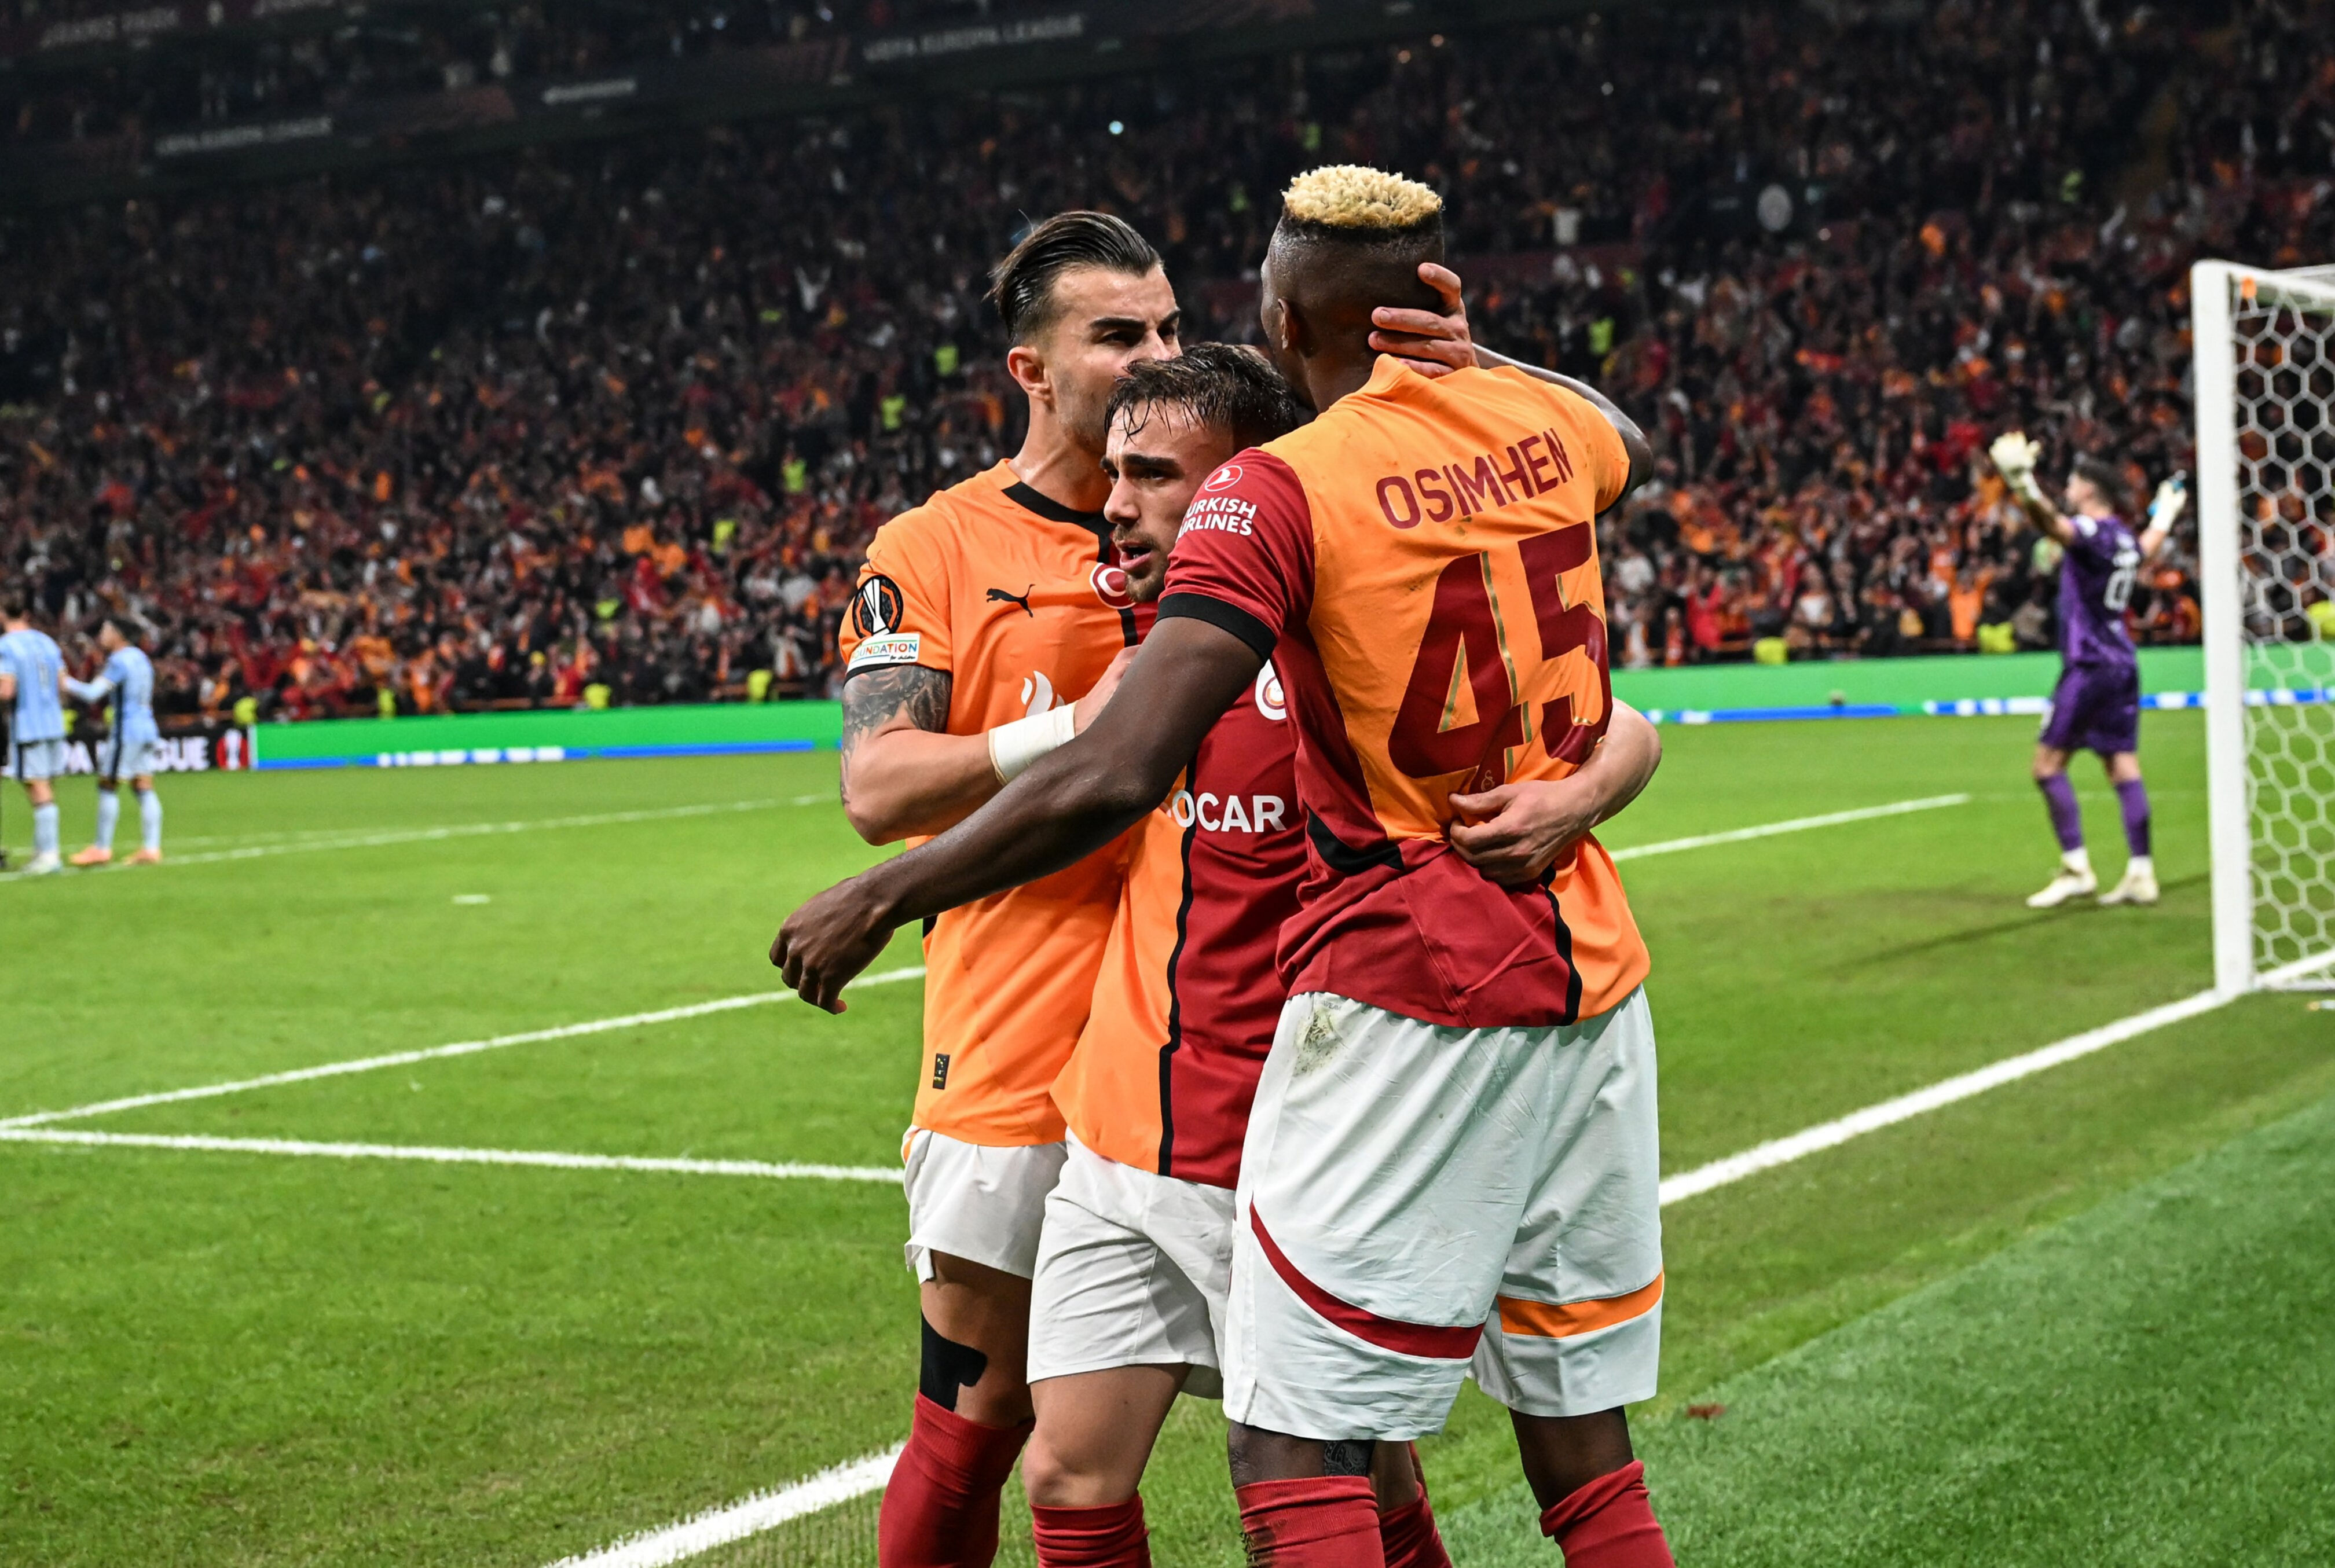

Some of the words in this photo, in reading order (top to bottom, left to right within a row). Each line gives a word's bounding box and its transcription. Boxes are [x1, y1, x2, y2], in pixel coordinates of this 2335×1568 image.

[1185, 497, 1257, 519] URKISH
[1376, 427, 1574, 529] OSIMHEN
[1387, 520, 1613, 794] 45
[1159, 789, 1287, 833] OCAR
